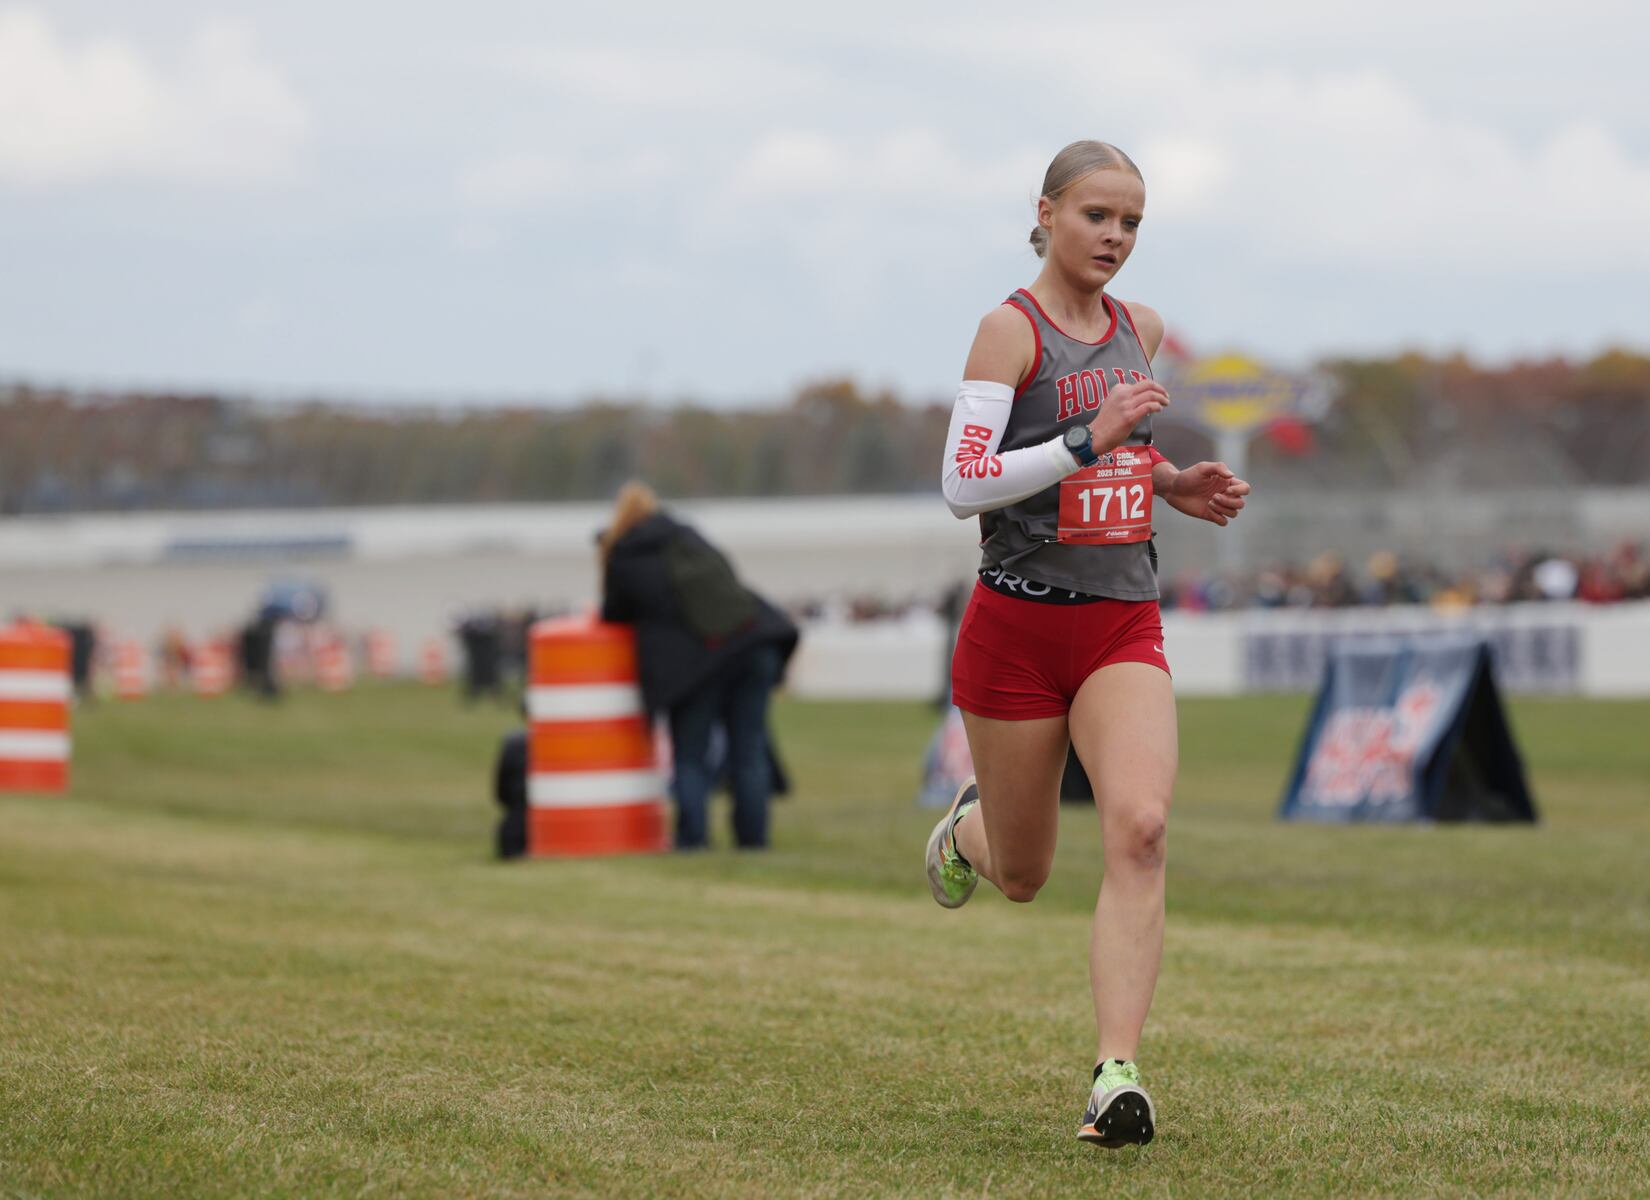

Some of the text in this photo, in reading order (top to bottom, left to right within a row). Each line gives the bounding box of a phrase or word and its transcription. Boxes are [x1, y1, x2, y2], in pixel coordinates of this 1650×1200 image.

[1096, 467, 1133, 478] 2025 FINAL
[1078, 484, 1145, 522] 1712
